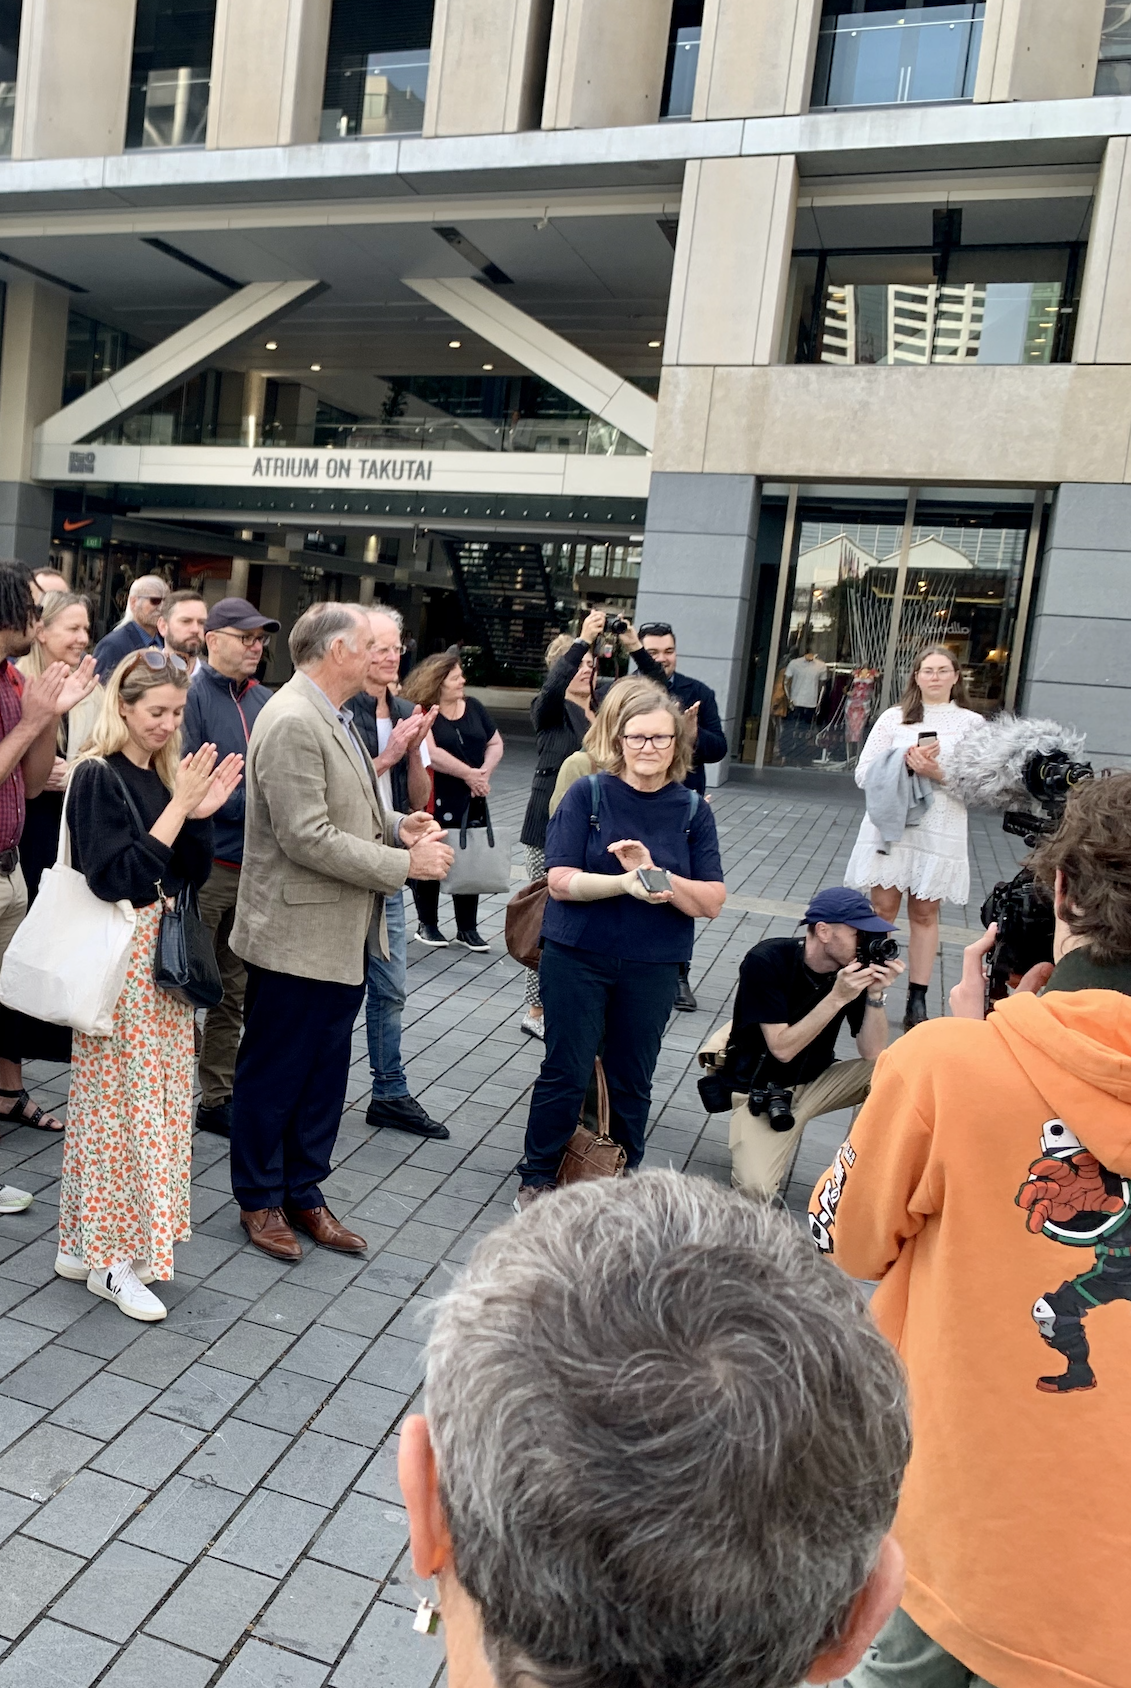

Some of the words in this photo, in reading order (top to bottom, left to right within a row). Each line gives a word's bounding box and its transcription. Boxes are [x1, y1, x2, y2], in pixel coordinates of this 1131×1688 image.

[252, 456, 319, 478] ATRIUM
[325, 458, 351, 479] ON
[358, 459, 433, 481] TAKUTAI
